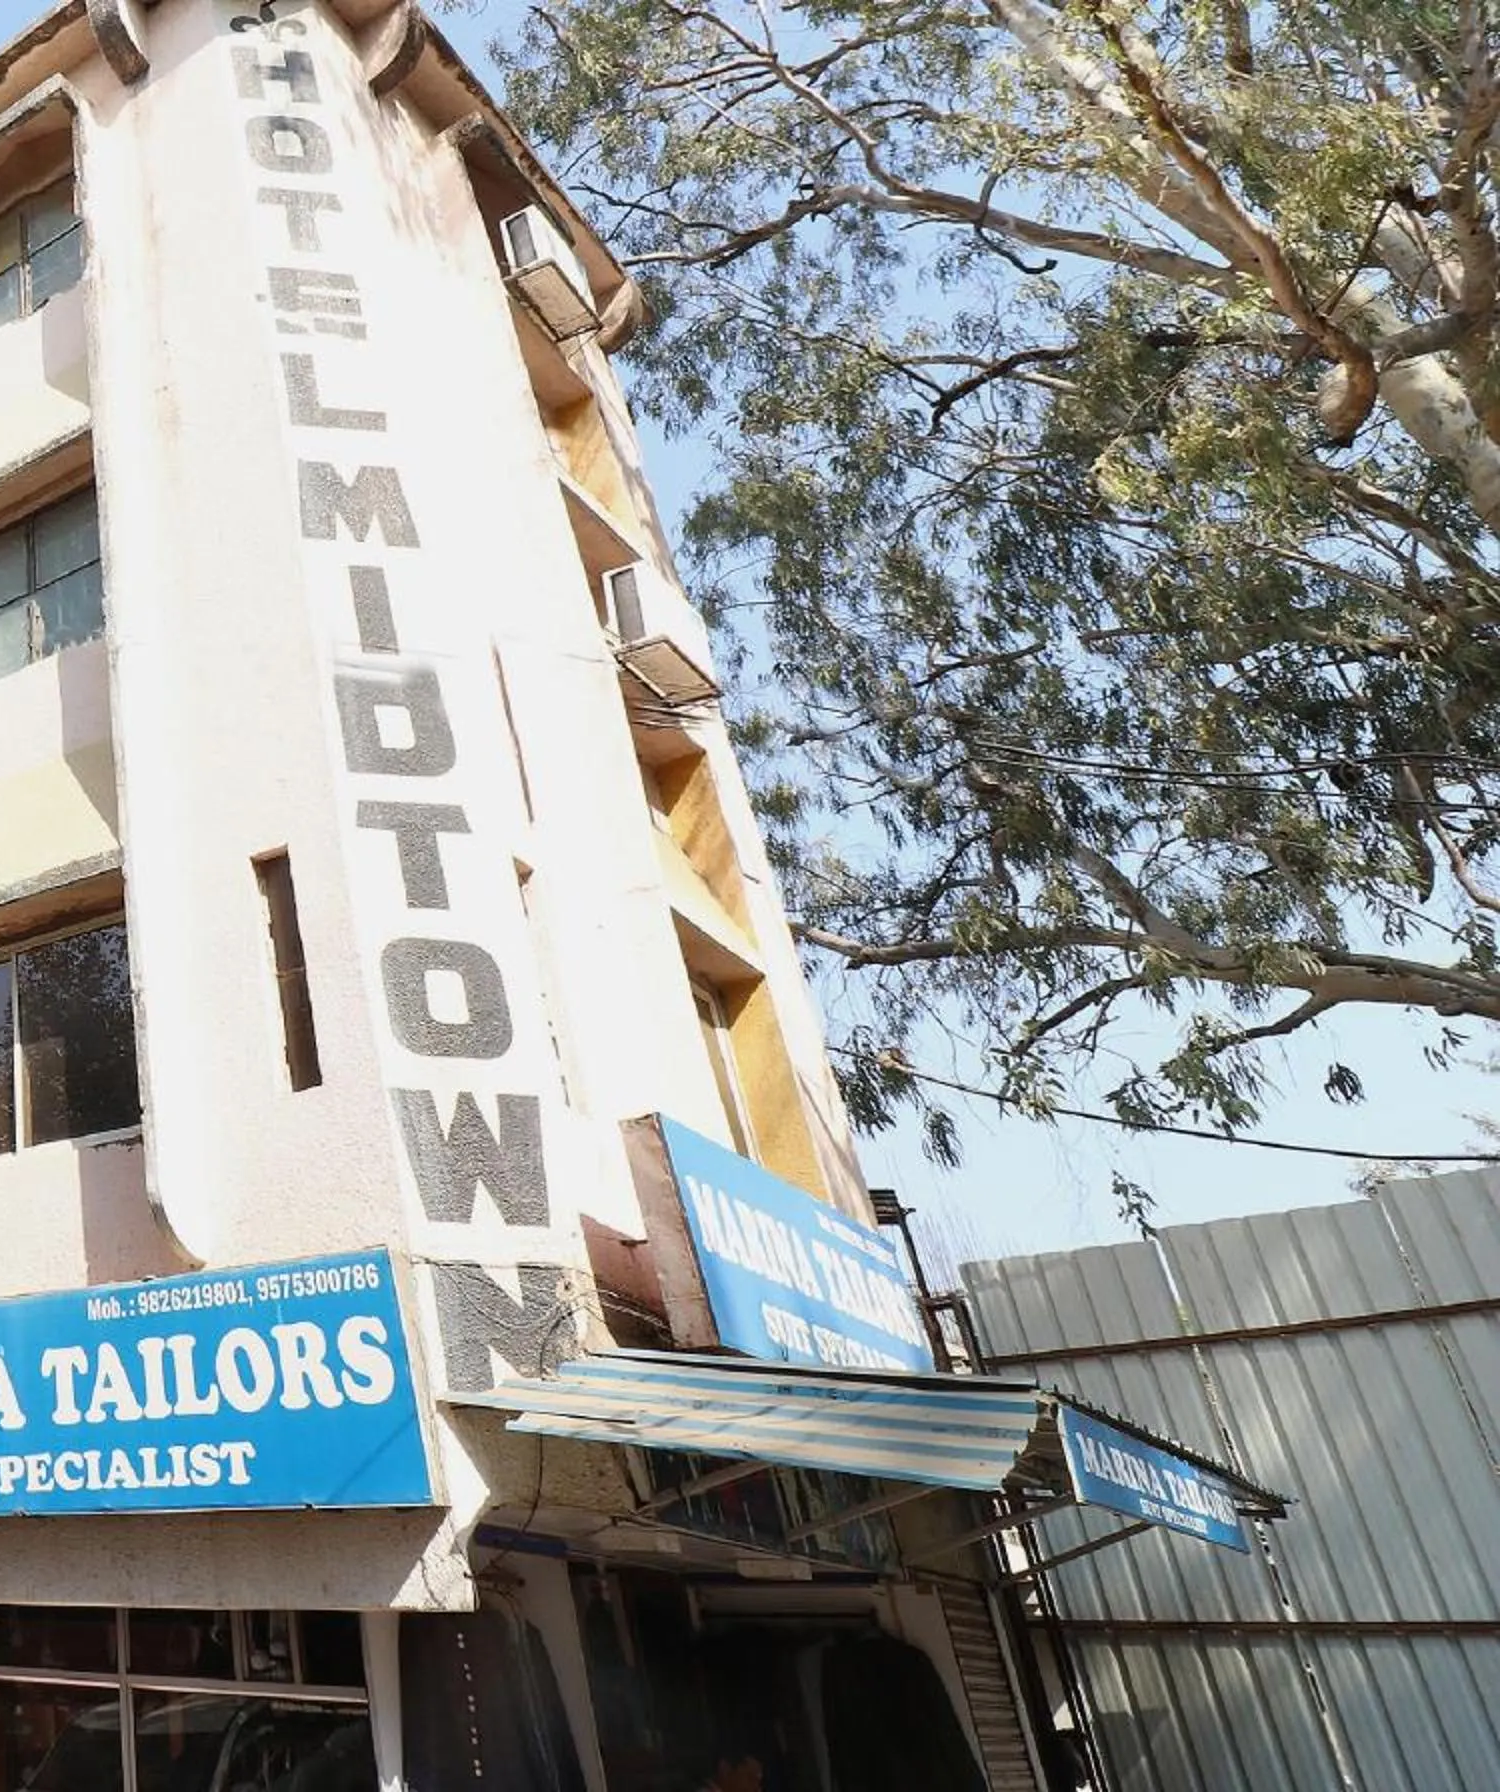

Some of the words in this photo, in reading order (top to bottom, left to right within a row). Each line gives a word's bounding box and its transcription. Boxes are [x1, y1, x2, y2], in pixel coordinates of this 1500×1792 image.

[230, 45, 387, 432] HOTEL
[298, 458, 580, 1394] MIDTOWN
[256, 1262, 380, 1301] 9575300786
[40, 1313, 397, 1427] TAILORS
[1075, 1431, 1169, 1501] MARINA
[1161, 1469, 1237, 1527] TAILORS
